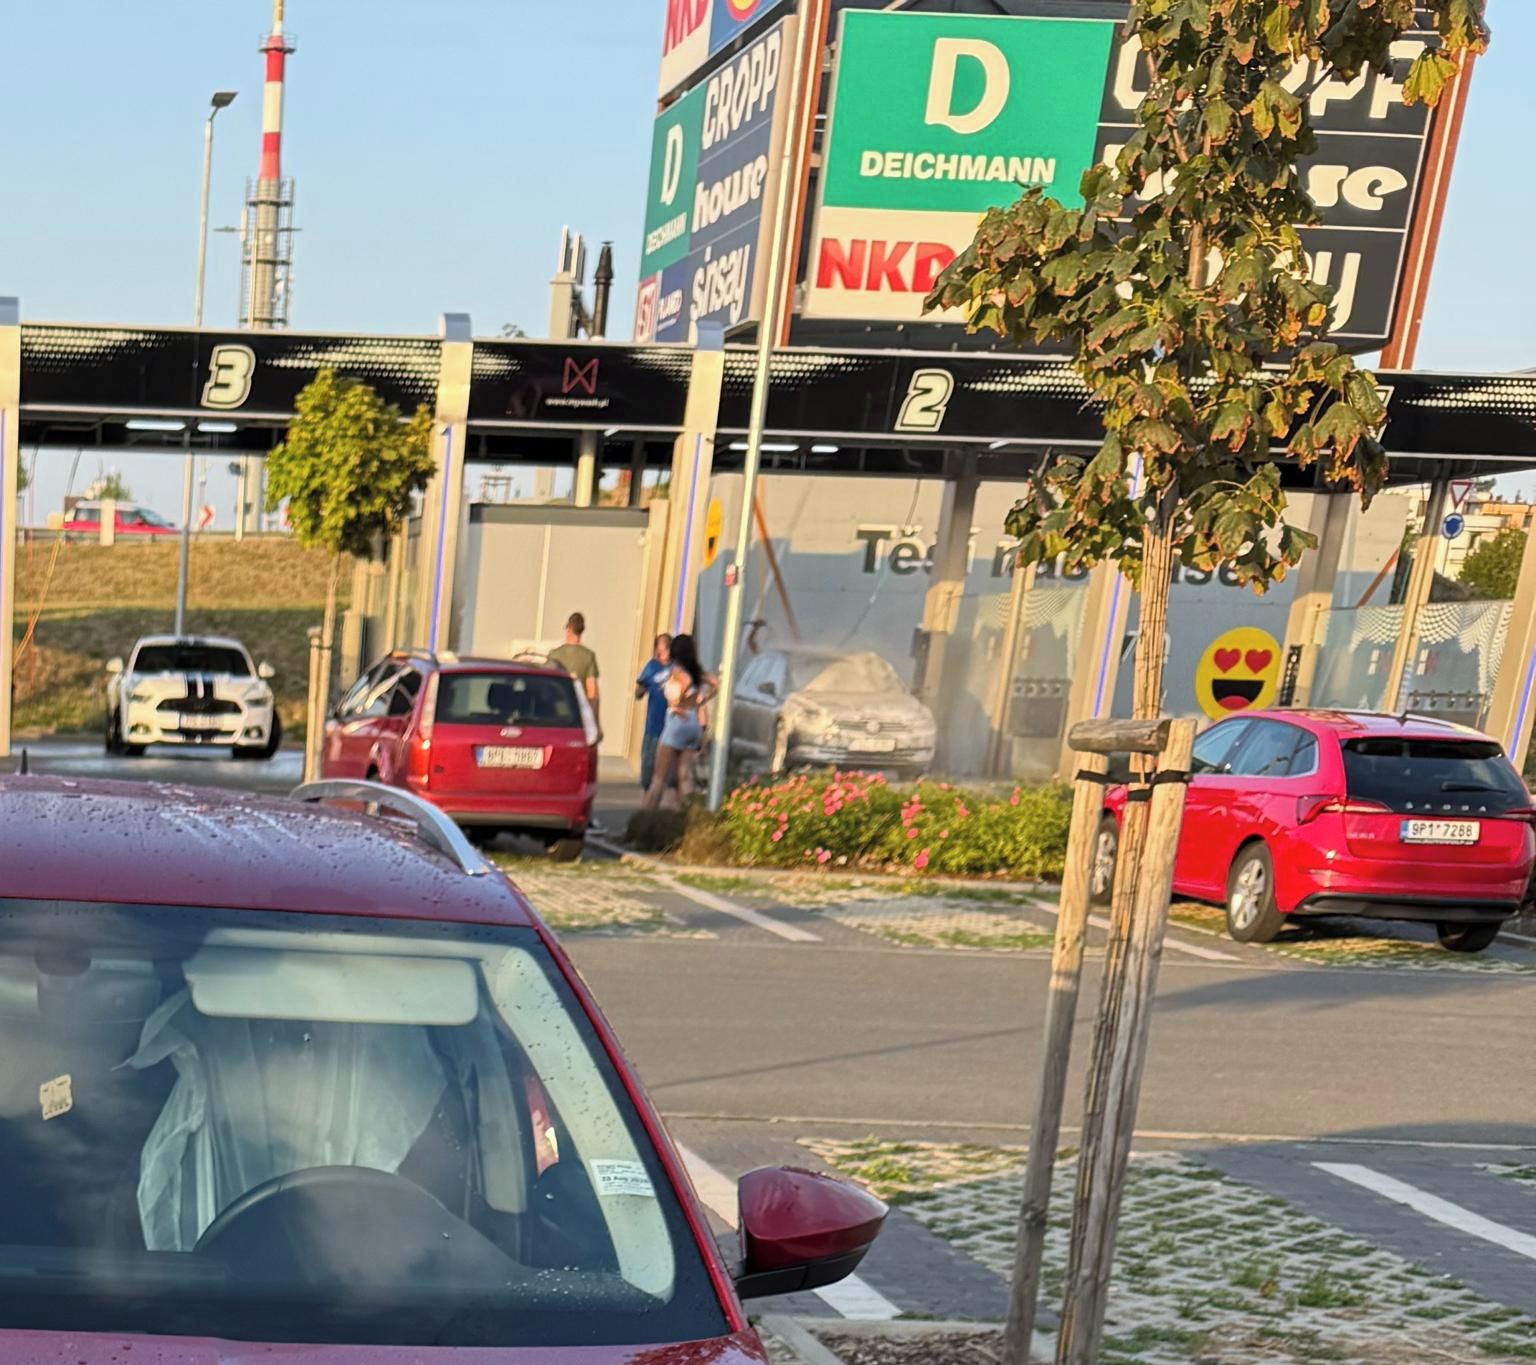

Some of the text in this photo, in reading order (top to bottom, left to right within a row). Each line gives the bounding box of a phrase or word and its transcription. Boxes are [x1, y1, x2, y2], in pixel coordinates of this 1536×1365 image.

[702, 30, 781, 150] CROPP
[924, 37, 1010, 134] D
[660, 124, 683, 207] D
[691, 154, 767, 233] house
[860, 150, 1056, 184] DEICHMANN
[690, 243, 750, 325] sinsay
[200, 345, 256, 409] 3
[894, 368, 954, 432] 2
